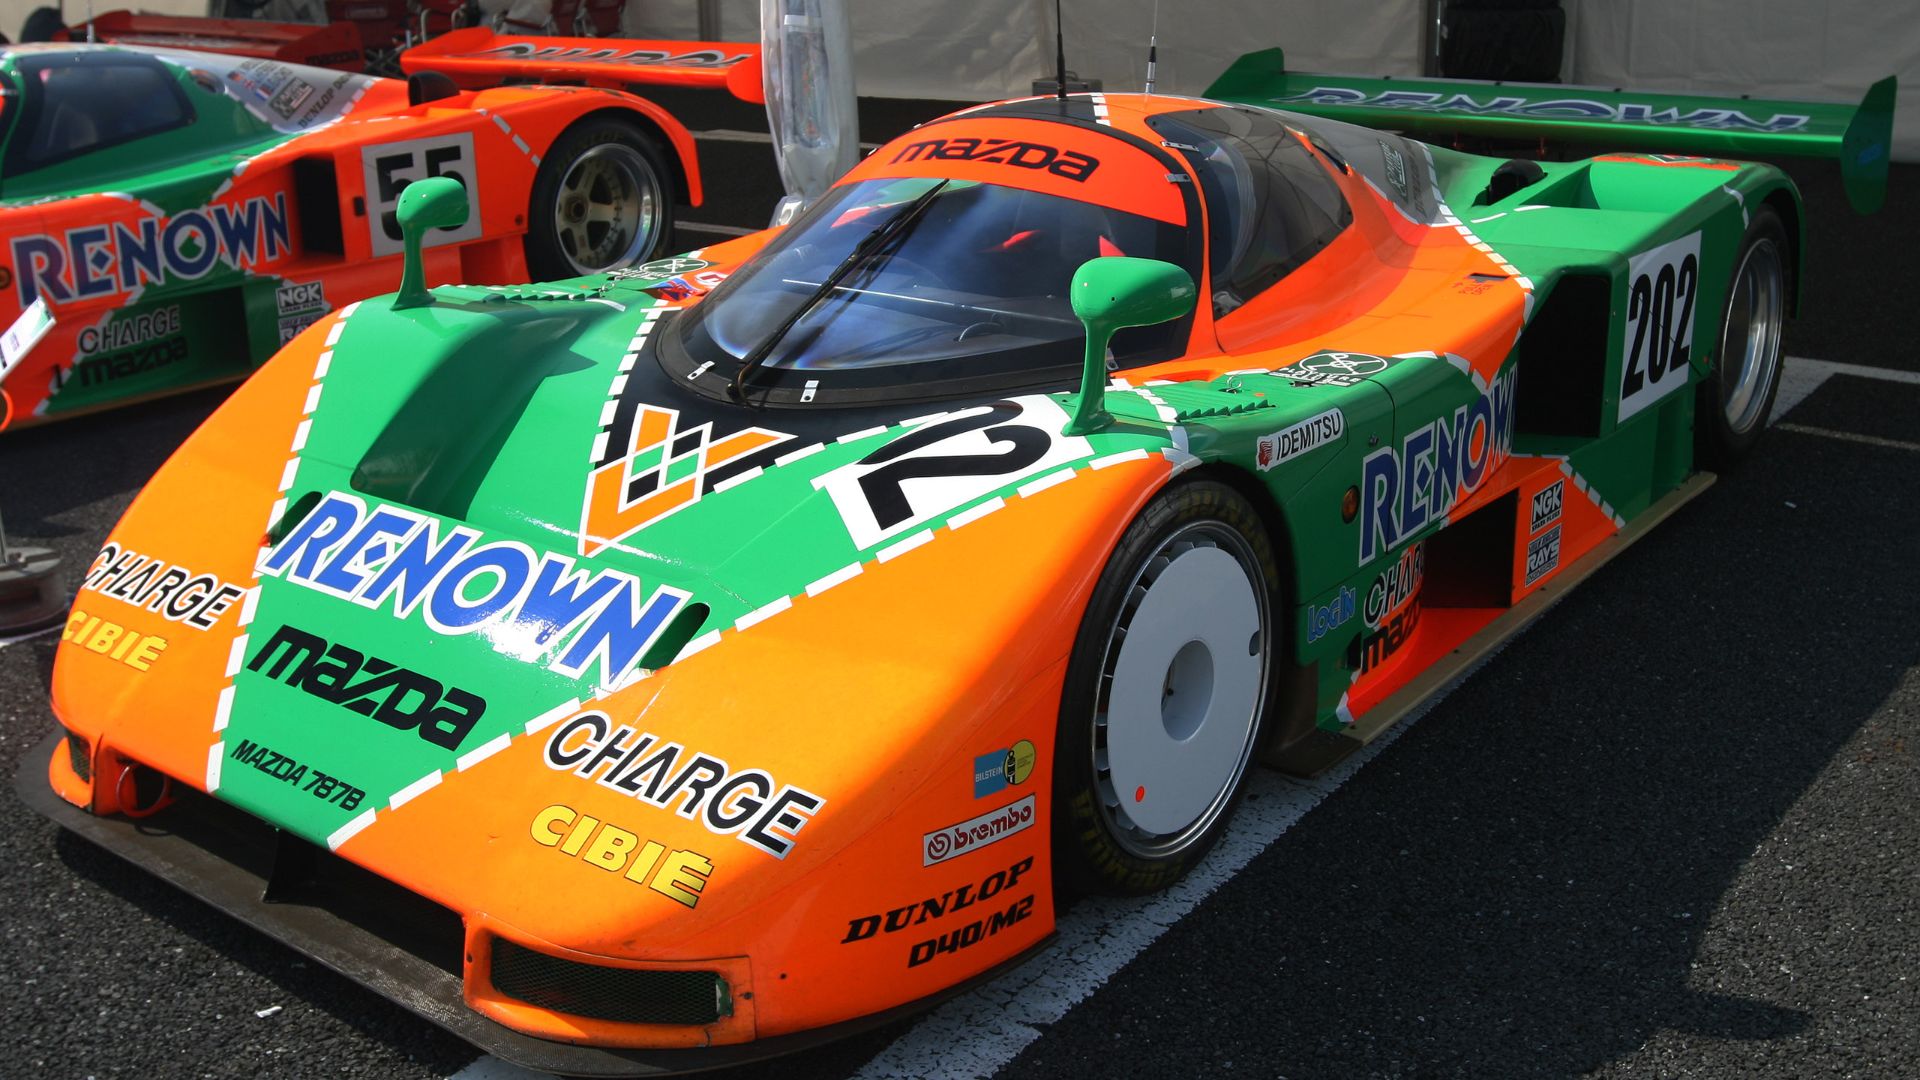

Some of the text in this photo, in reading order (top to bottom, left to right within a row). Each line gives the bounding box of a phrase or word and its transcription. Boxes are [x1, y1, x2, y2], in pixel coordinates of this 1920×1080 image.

[11, 191, 291, 310] RENOWN
[79, 304, 180, 355] CHARGE
[279, 284, 321, 307] NGK
[1622, 253, 1697, 400] 202
[1277, 412, 1340, 461] IDEMITSU
[1532, 482, 1562, 523] NGK
[83, 541, 247, 632] CHARGE
[256, 490, 694, 692] RENOWN
[1528, 541, 1560, 576] RAYS
[246, 624, 487, 752] mazda
[230, 739, 366, 811] MAZDA 787B
[544, 710, 827, 860] CHARGE
[975, 766, 1004, 783] BILSTEIN
[954, 805, 1032, 850] brembo
[841, 855, 1034, 943] DUNLOP
[908, 894, 1035, 969] D40/M2
